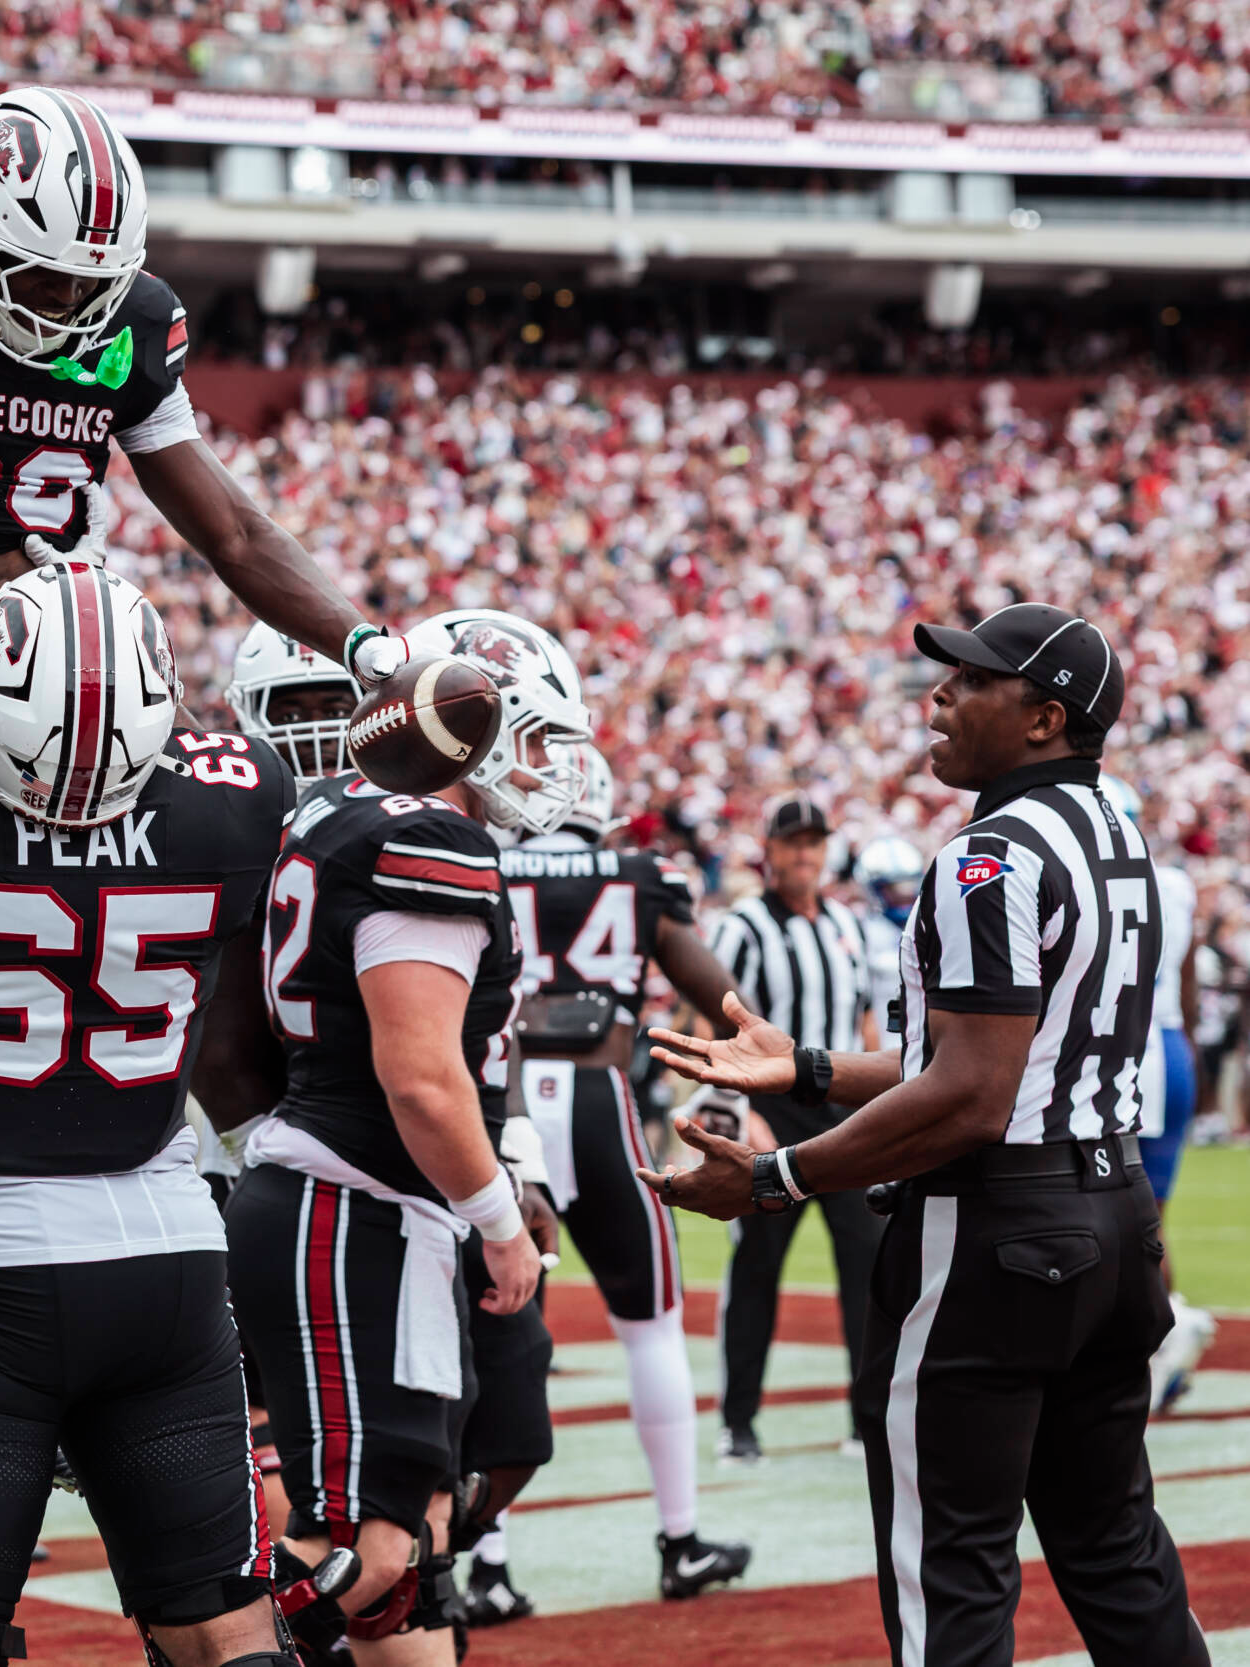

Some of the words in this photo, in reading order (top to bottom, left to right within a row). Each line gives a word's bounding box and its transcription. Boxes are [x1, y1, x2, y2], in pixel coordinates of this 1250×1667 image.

[175, 731, 260, 790] 65
[22, 790, 49, 809] SEC
[14, 811, 158, 867] PEAK
[500, 850, 594, 877] ROWN
[965, 868, 990, 879] CFO
[262, 853, 318, 1042] 2
[1090, 878, 1148, 1037] F
